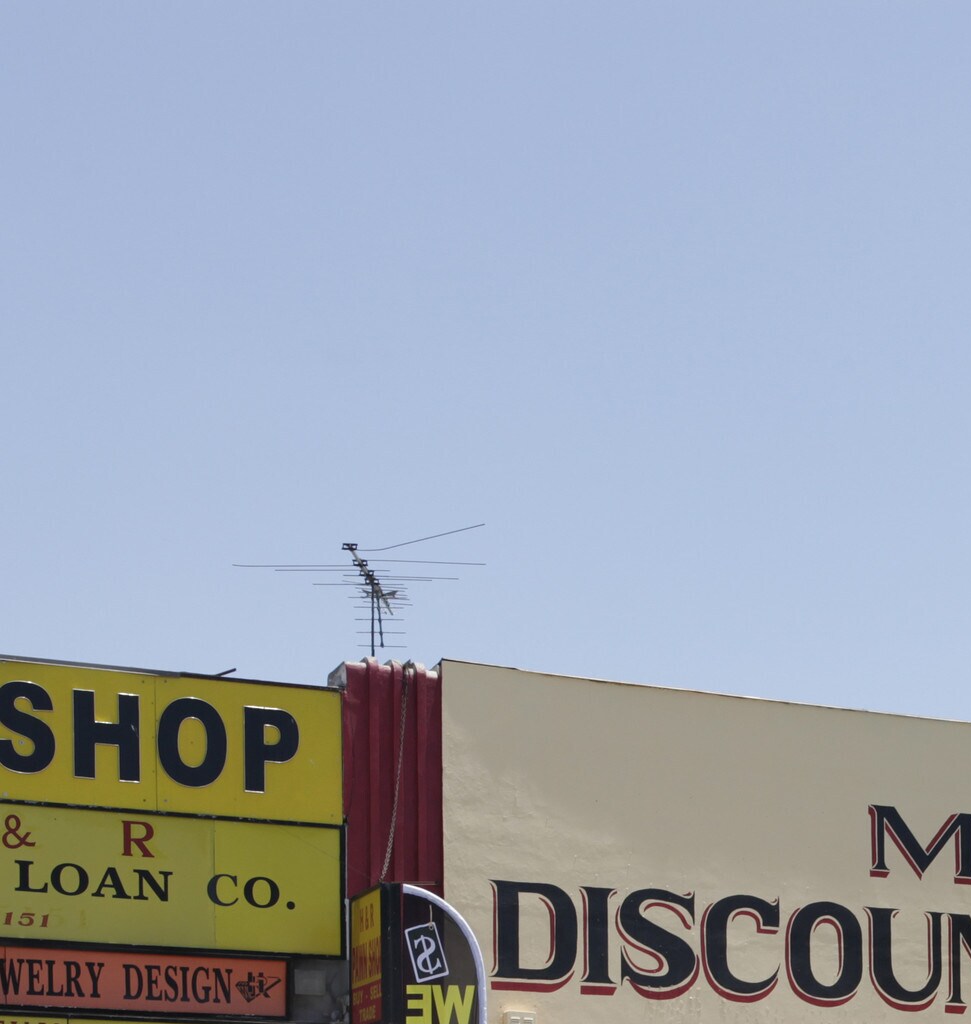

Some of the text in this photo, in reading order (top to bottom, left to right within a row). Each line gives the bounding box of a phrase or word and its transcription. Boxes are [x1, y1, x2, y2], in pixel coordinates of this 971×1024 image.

[0, 680, 300, 794] SHOP
[2, 814, 156, 858] & R
[15, 860, 296, 910] LOAN CO.
[122, 964, 233, 1004] DESIGN
